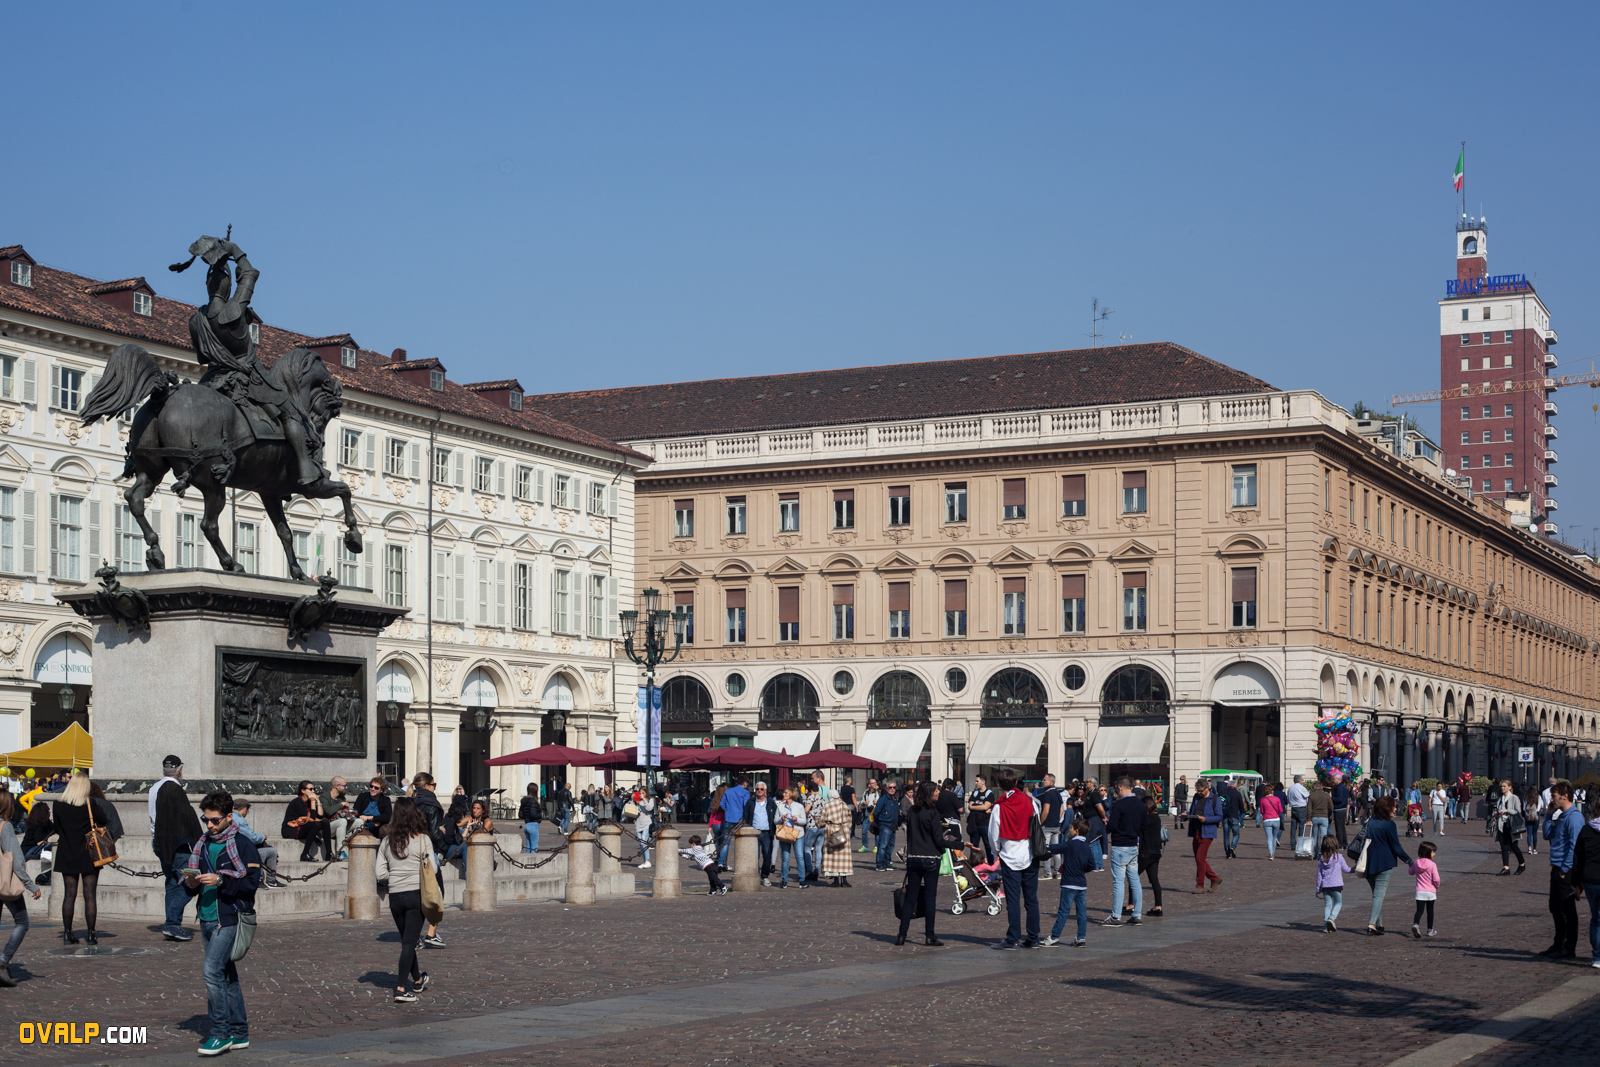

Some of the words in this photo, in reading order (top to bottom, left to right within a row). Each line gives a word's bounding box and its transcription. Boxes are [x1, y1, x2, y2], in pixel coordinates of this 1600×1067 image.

[1446, 277, 1483, 295] REALE
[1487, 273, 1528, 292] MUTUA
[60, 663, 92, 674] SANPAOLO
